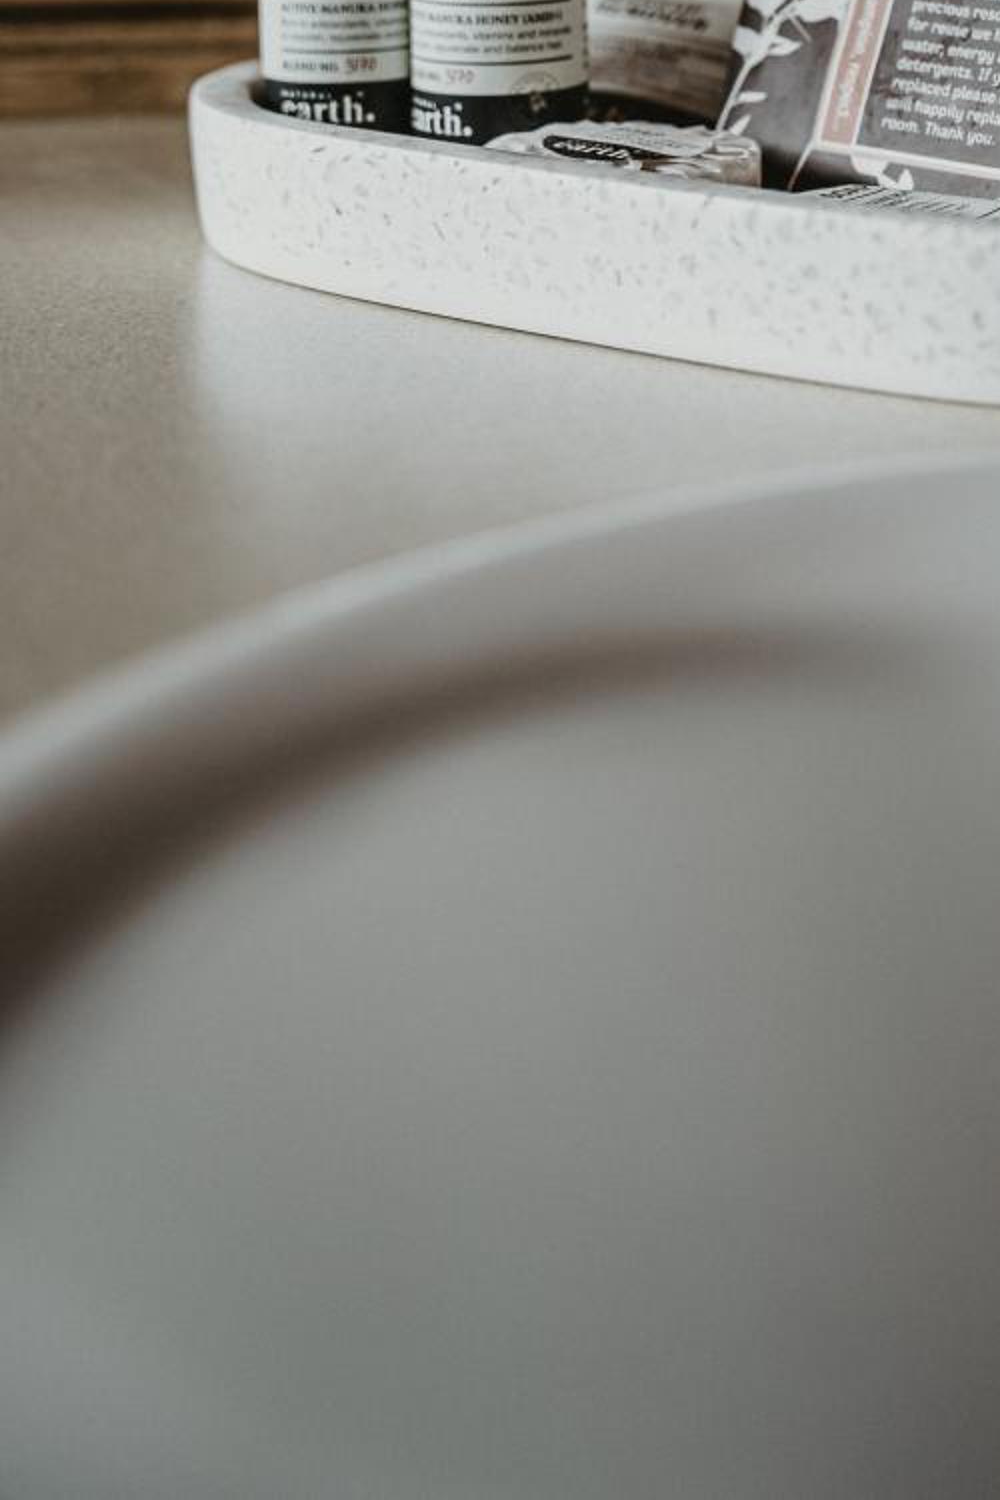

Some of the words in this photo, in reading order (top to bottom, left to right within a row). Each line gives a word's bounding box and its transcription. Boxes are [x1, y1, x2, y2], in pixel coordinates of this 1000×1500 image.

[911, 0, 970, 18] precious
[907, 16, 929, 32] for
[971, 29, 993, 41] we
[901, 39, 944, 58] water,
[947, 45, 995, 65] energy
[978, 67, 993, 81] If
[892, 77, 951, 97] replaced
[952, 85, 996, 103] please
[886, 98, 912, 112] will
[914, 100, 965, 123] happily
[881, 117, 919, 134] room.
[924, 121, 964, 141] Thank
[966, 131, 996, 147] you.
